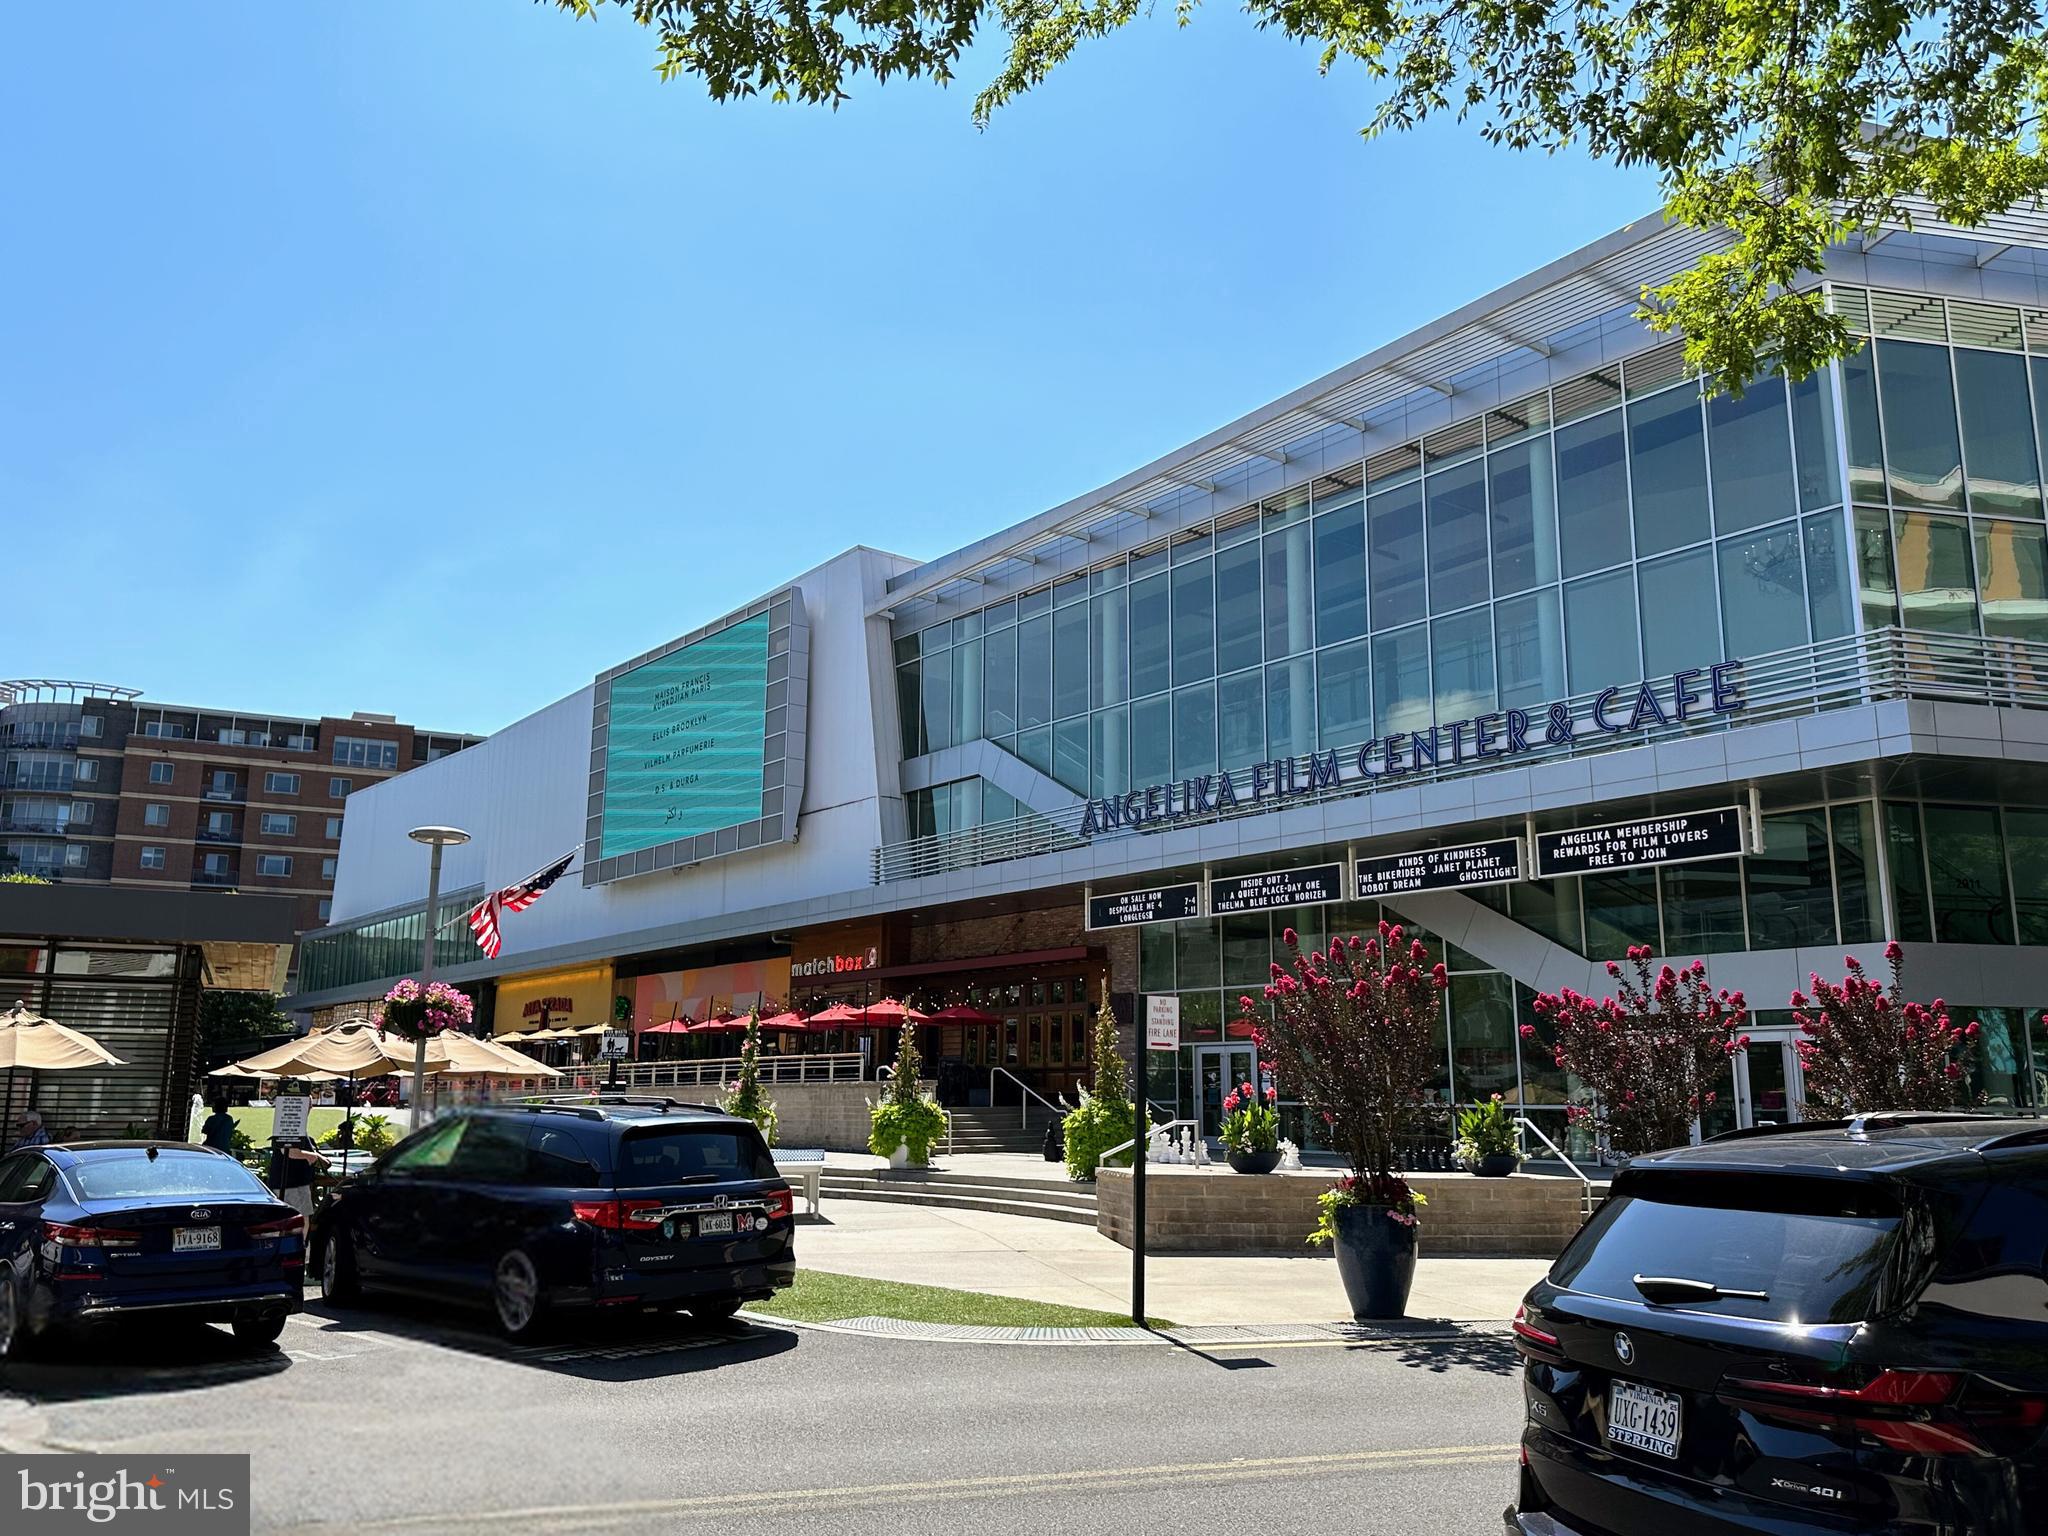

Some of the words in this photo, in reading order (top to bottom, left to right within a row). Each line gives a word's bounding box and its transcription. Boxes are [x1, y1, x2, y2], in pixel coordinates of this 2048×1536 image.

[655, 685, 679, 700] MAISON
[682, 673, 710, 690] FRANCIS
[653, 691, 689, 712] KURKDJIAN
[692, 682, 711, 696] PARIS
[653, 728, 670, 741] ELLIS
[672, 714, 707, 734] BROOKLYN
[644, 753, 670, 769] VILHELM
[673, 738, 715, 759] PARFUMERIE
[1079, 769, 1237, 836] ANGELIKA
[1251, 747, 1341, 801] FILM
[1356, 708, 1529, 779] CENTER
[1546, 703, 1574, 745] &
[1592, 660, 1743, 733] CAFE
[676, 774, 699, 788] DURGA
[1560, 830, 1611, 846] ANGELIKA
[1617, 819, 1688, 839] MEMBERSHIP
[1553, 844, 1600, 859] REWARDS
[1606, 840, 1626, 852] FOR
[1633, 837, 1658, 849] FILM
[1665, 829, 1709, 845] LOVERS
[1399, 856, 1423, 868] KINDS
[1428, 853, 1439, 863] OF
[1444, 848, 1487, 862] KINDNESS
[1589, 856, 1614, 867] FREE
[1620, 852, 1635, 863] TO
[1640, 848, 1667, 859] JOIN
[1359, 874, 1373, 884] THE
[1377, 866, 1426, 881] BIKERIDERS
[1433, 862, 1461, 874] JANET
[1466, 857, 1500, 870] PLANET
[1362, 882, 1389, 894] ROBOT
[1393, 878, 1421, 890] DREAM
[1459, 866, 1517, 882] GHOSTLIGHT
[1230, 892, 1235, 900] A
[1238, 888, 1259, 899] QUIET
[1306, 880, 1320, 890] ONE
[1241, 878, 1263, 889] INSIDE
[1267, 876, 1281, 885] OUT
[1284, 874, 1289, 882] 2
[1109, 905, 1144, 915] DESPICABLE
[1147, 902, 1155, 910] ME
[1158, 901, 1162, 909] 4
[1120, 897, 1128, 905] ON
[1131, 894, 1146, 903] SALE
[1149, 892, 1162, 901] NOW
[1218, 900, 1245, 911] THELMA
[1250, 897, 1268, 907] BLUE
[1271, 894, 1290, 904] LOCK
[1295, 890, 1327, 901] HORIZEN
[1120, 911, 1151, 922] LONGLEGS
[791, 955, 864, 977] matchbox
[1153, 1006, 1173, 1014] PARKING
[1152, 1018, 1174, 1026] STANDING
[1149, 1028, 1161, 1038] FIRE
[1163, 1029, 1177, 1038] LANE
[177, 1232, 218, 1246] TVA-9168
[640, 1254, 674, 1262] ODYSSEY
[1630, 1391, 1663, 1406] VIRGINIA
[1615, 1397, 1676, 1438] UXG-1439
[1608, 1427, 1673, 1456] STERLING
